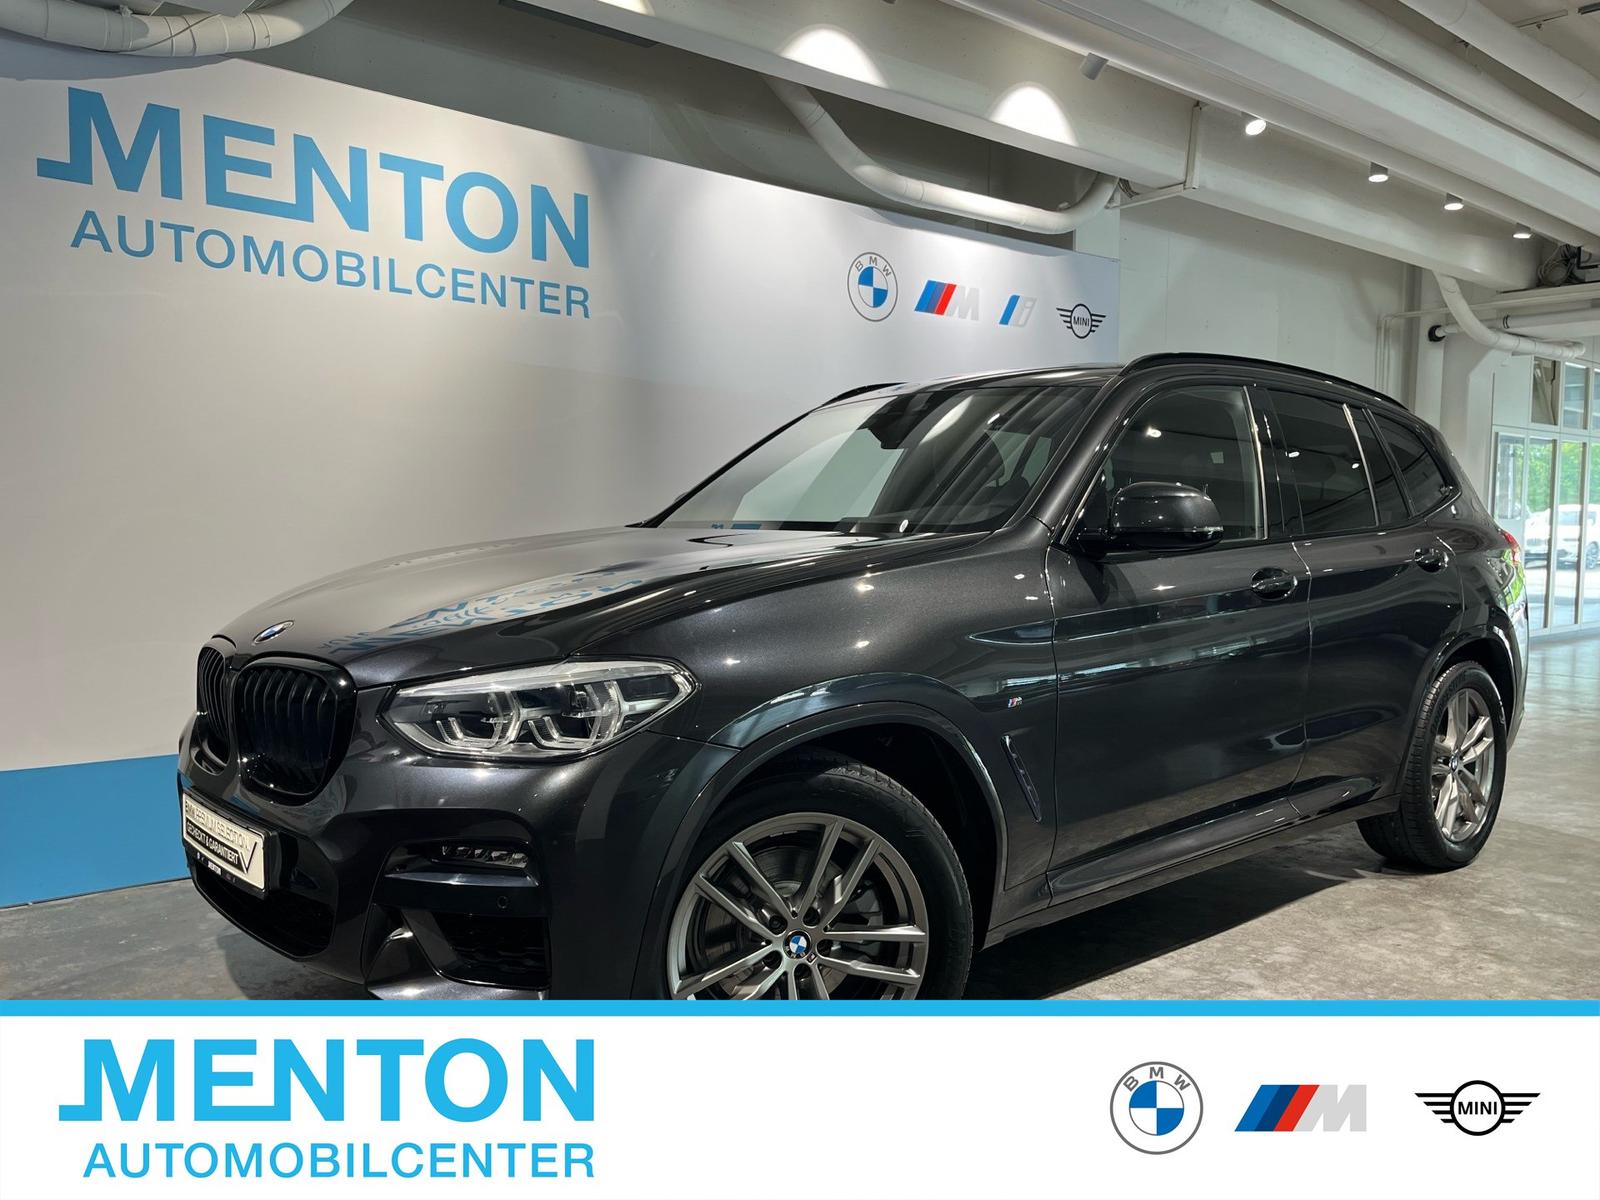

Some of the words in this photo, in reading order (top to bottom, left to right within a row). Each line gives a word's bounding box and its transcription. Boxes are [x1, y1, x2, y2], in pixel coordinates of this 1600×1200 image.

[37, 86, 590, 269] MENTON
[71, 210, 590, 319] AUTOMOBILCENTER
[1073, 317, 1090, 328] MINI
